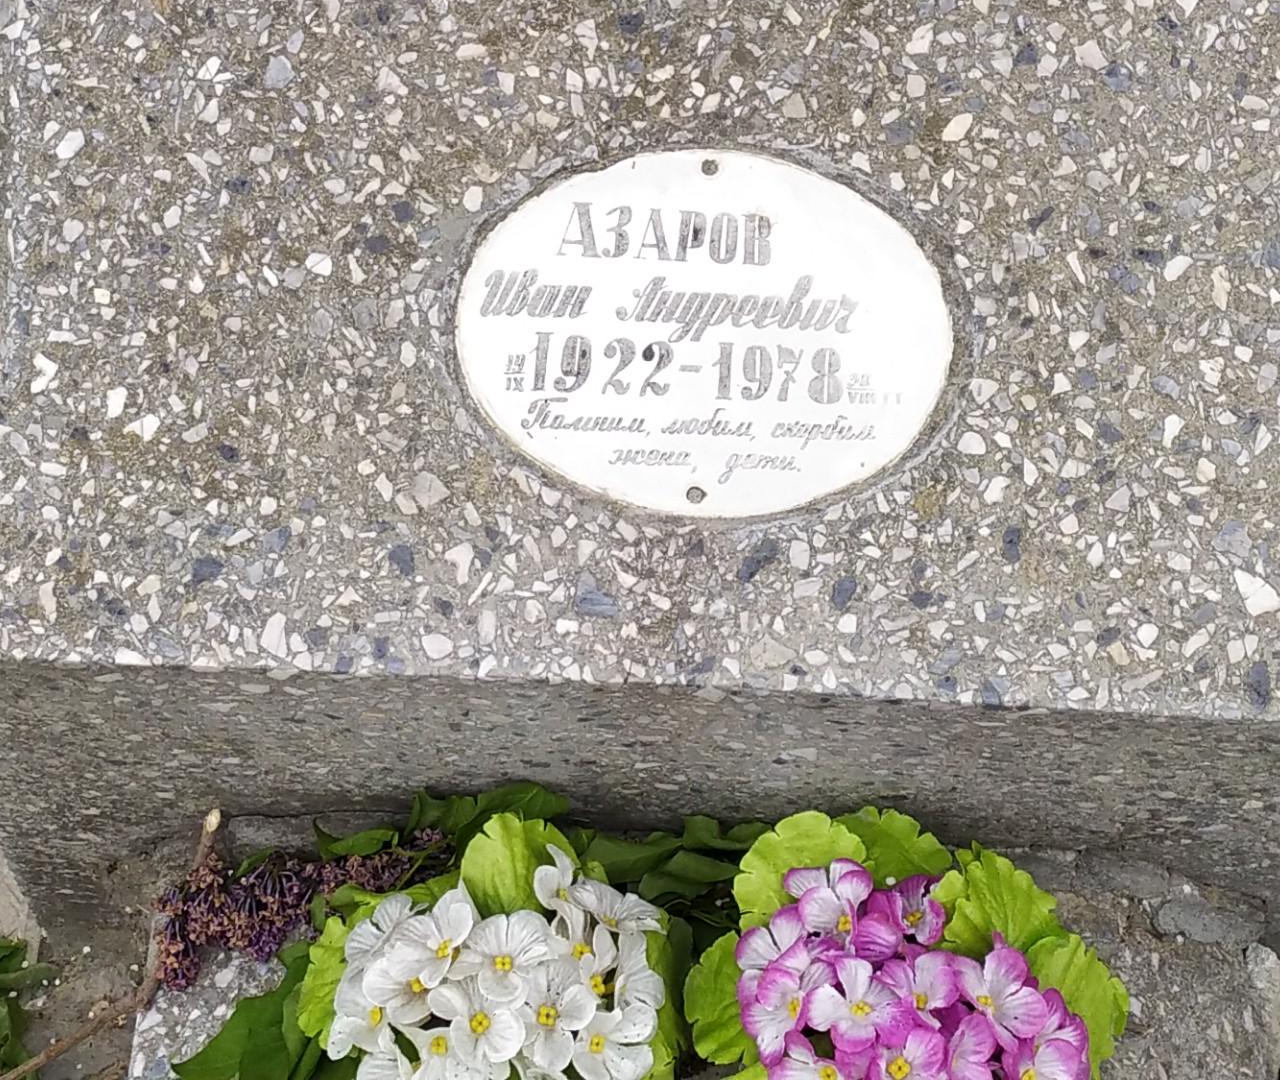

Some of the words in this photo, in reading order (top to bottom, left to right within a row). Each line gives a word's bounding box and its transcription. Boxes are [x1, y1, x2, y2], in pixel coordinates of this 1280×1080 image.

[557, 201, 773, 266] АЗАРОВ
[479, 268, 594, 319] Иван
[615, 274, 859, 343] Андреевич
